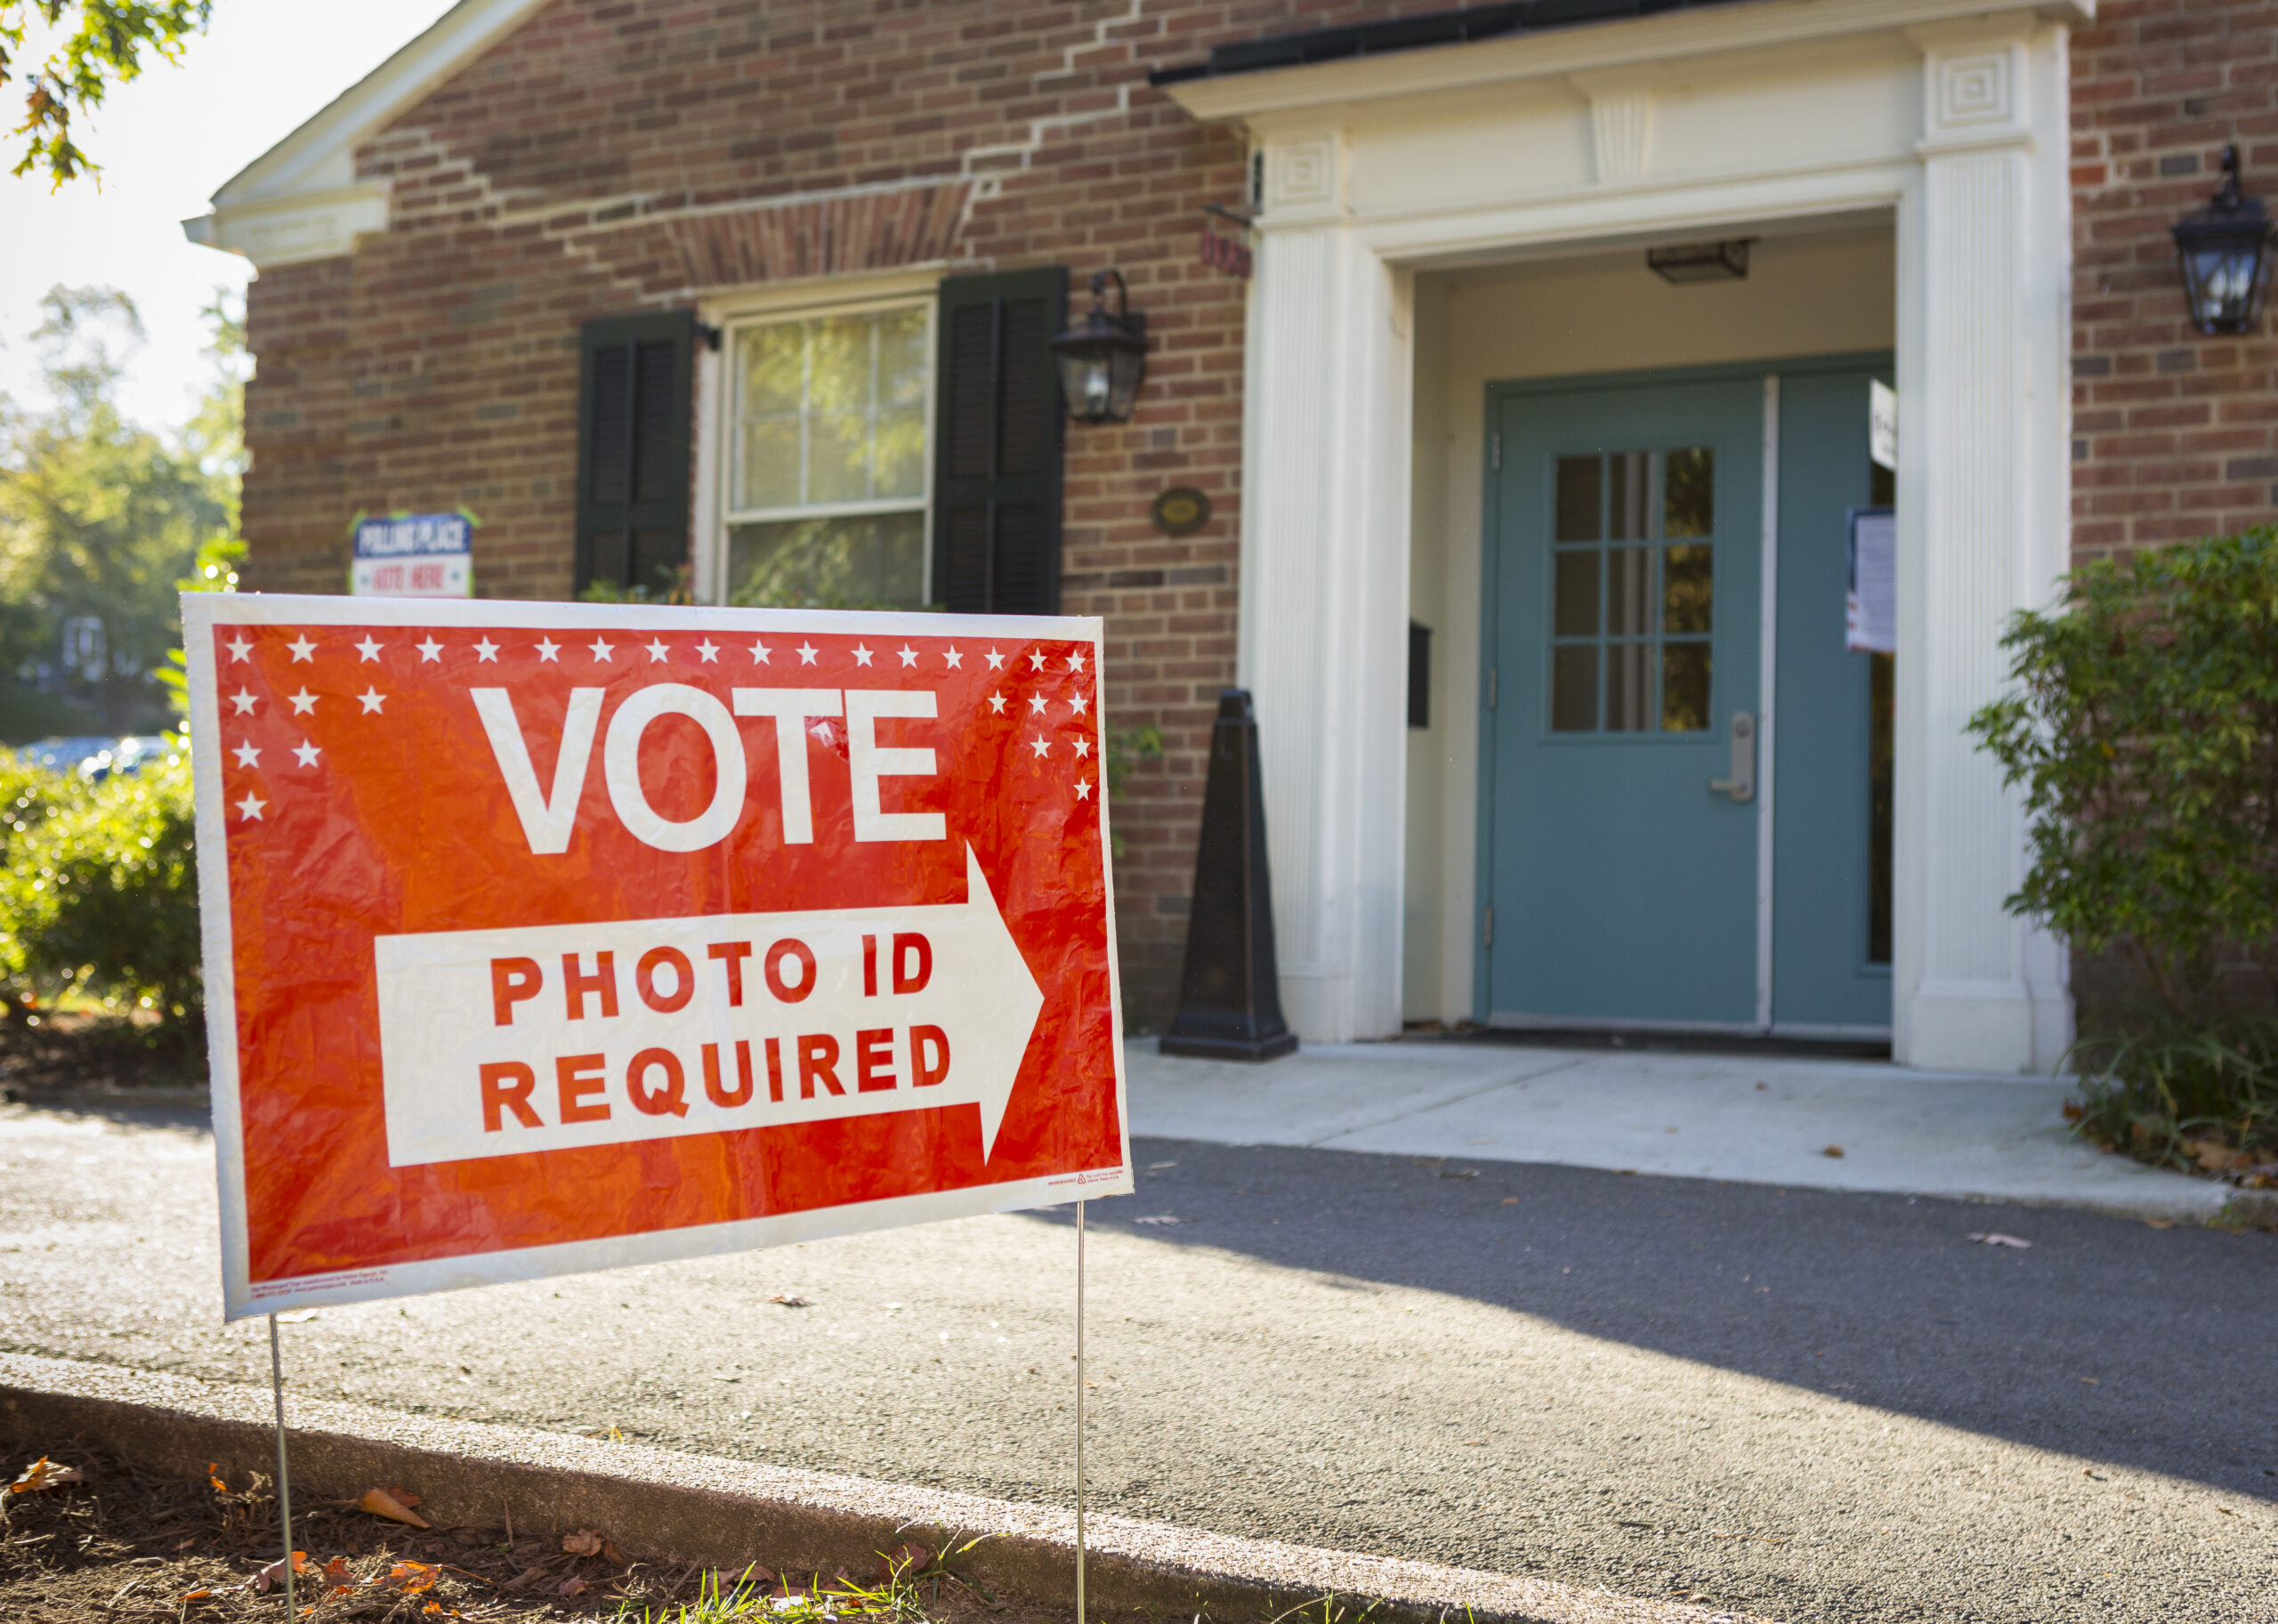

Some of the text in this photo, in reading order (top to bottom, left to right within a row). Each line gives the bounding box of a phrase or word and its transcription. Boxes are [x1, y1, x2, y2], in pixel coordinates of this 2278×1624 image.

[373, 563, 444, 592] VOTE HERE
[418, 519, 465, 552] PLACE
[470, 682, 946, 855] VOTE
[491, 932, 933, 1026] PHOTO ID
[478, 1023, 951, 1133] REQUIRED
